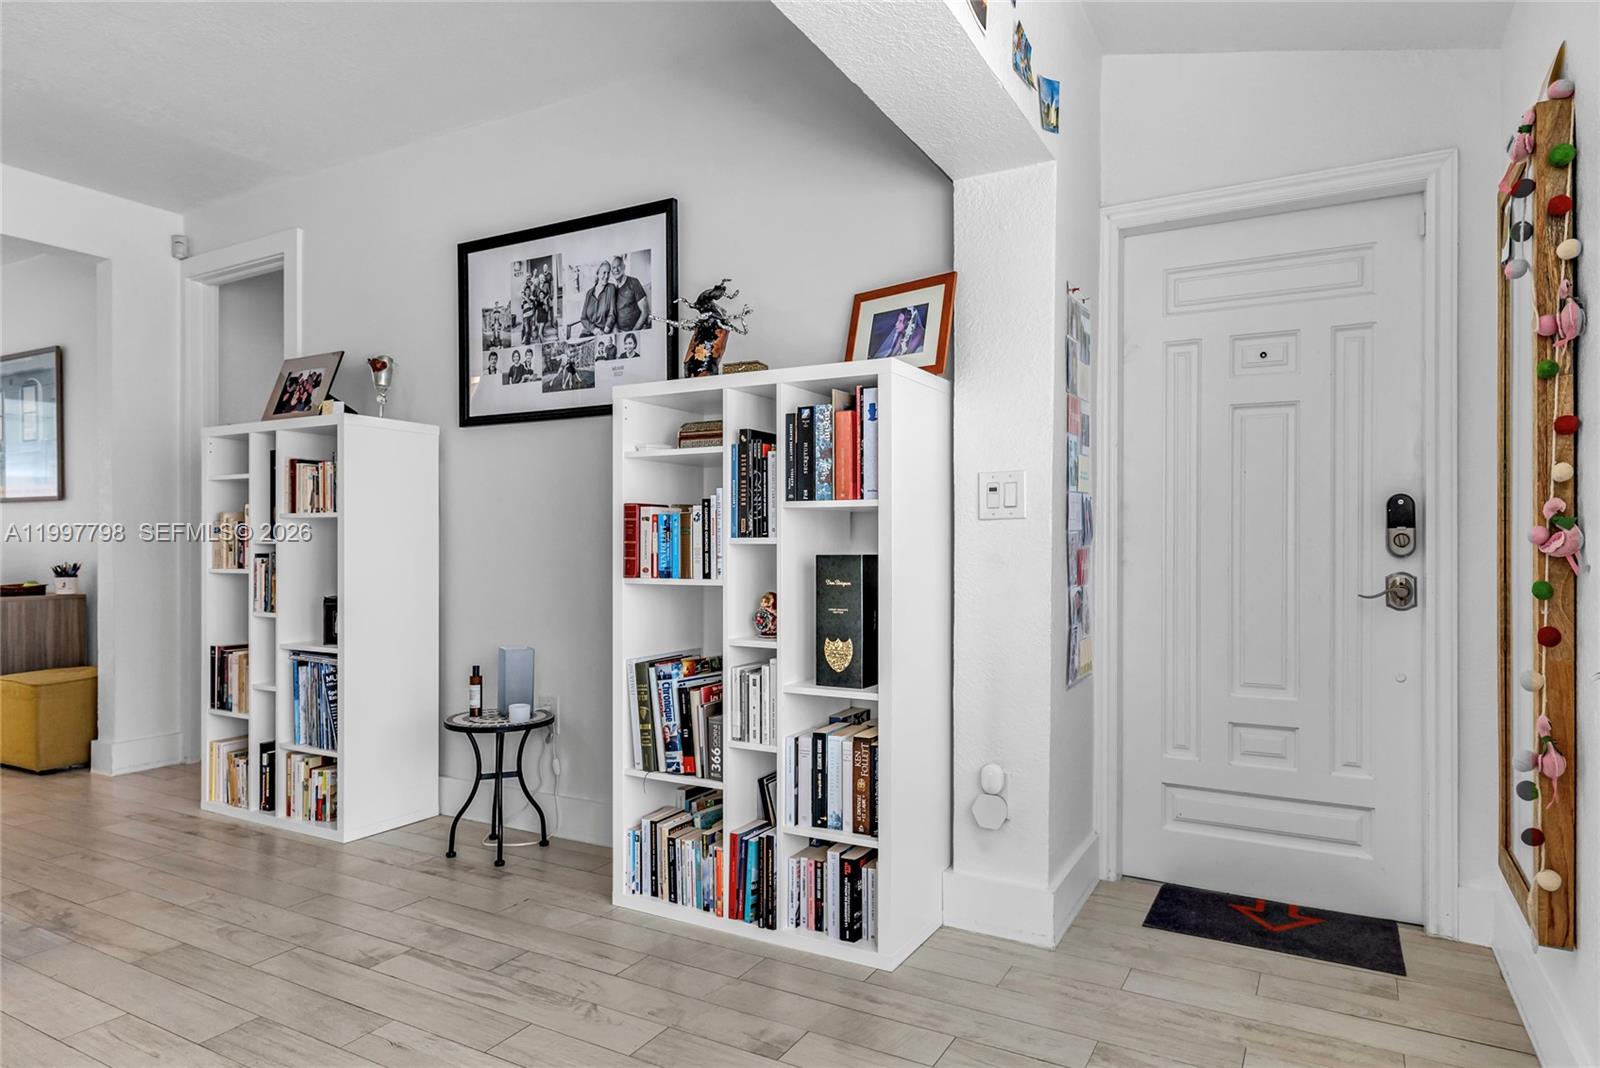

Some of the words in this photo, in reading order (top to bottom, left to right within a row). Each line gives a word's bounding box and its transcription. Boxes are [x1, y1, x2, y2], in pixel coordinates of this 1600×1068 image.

[662, 682, 673, 722] Chronique
[712, 748, 721, 772] 366
[861, 742, 869, 777] FOLLETT
